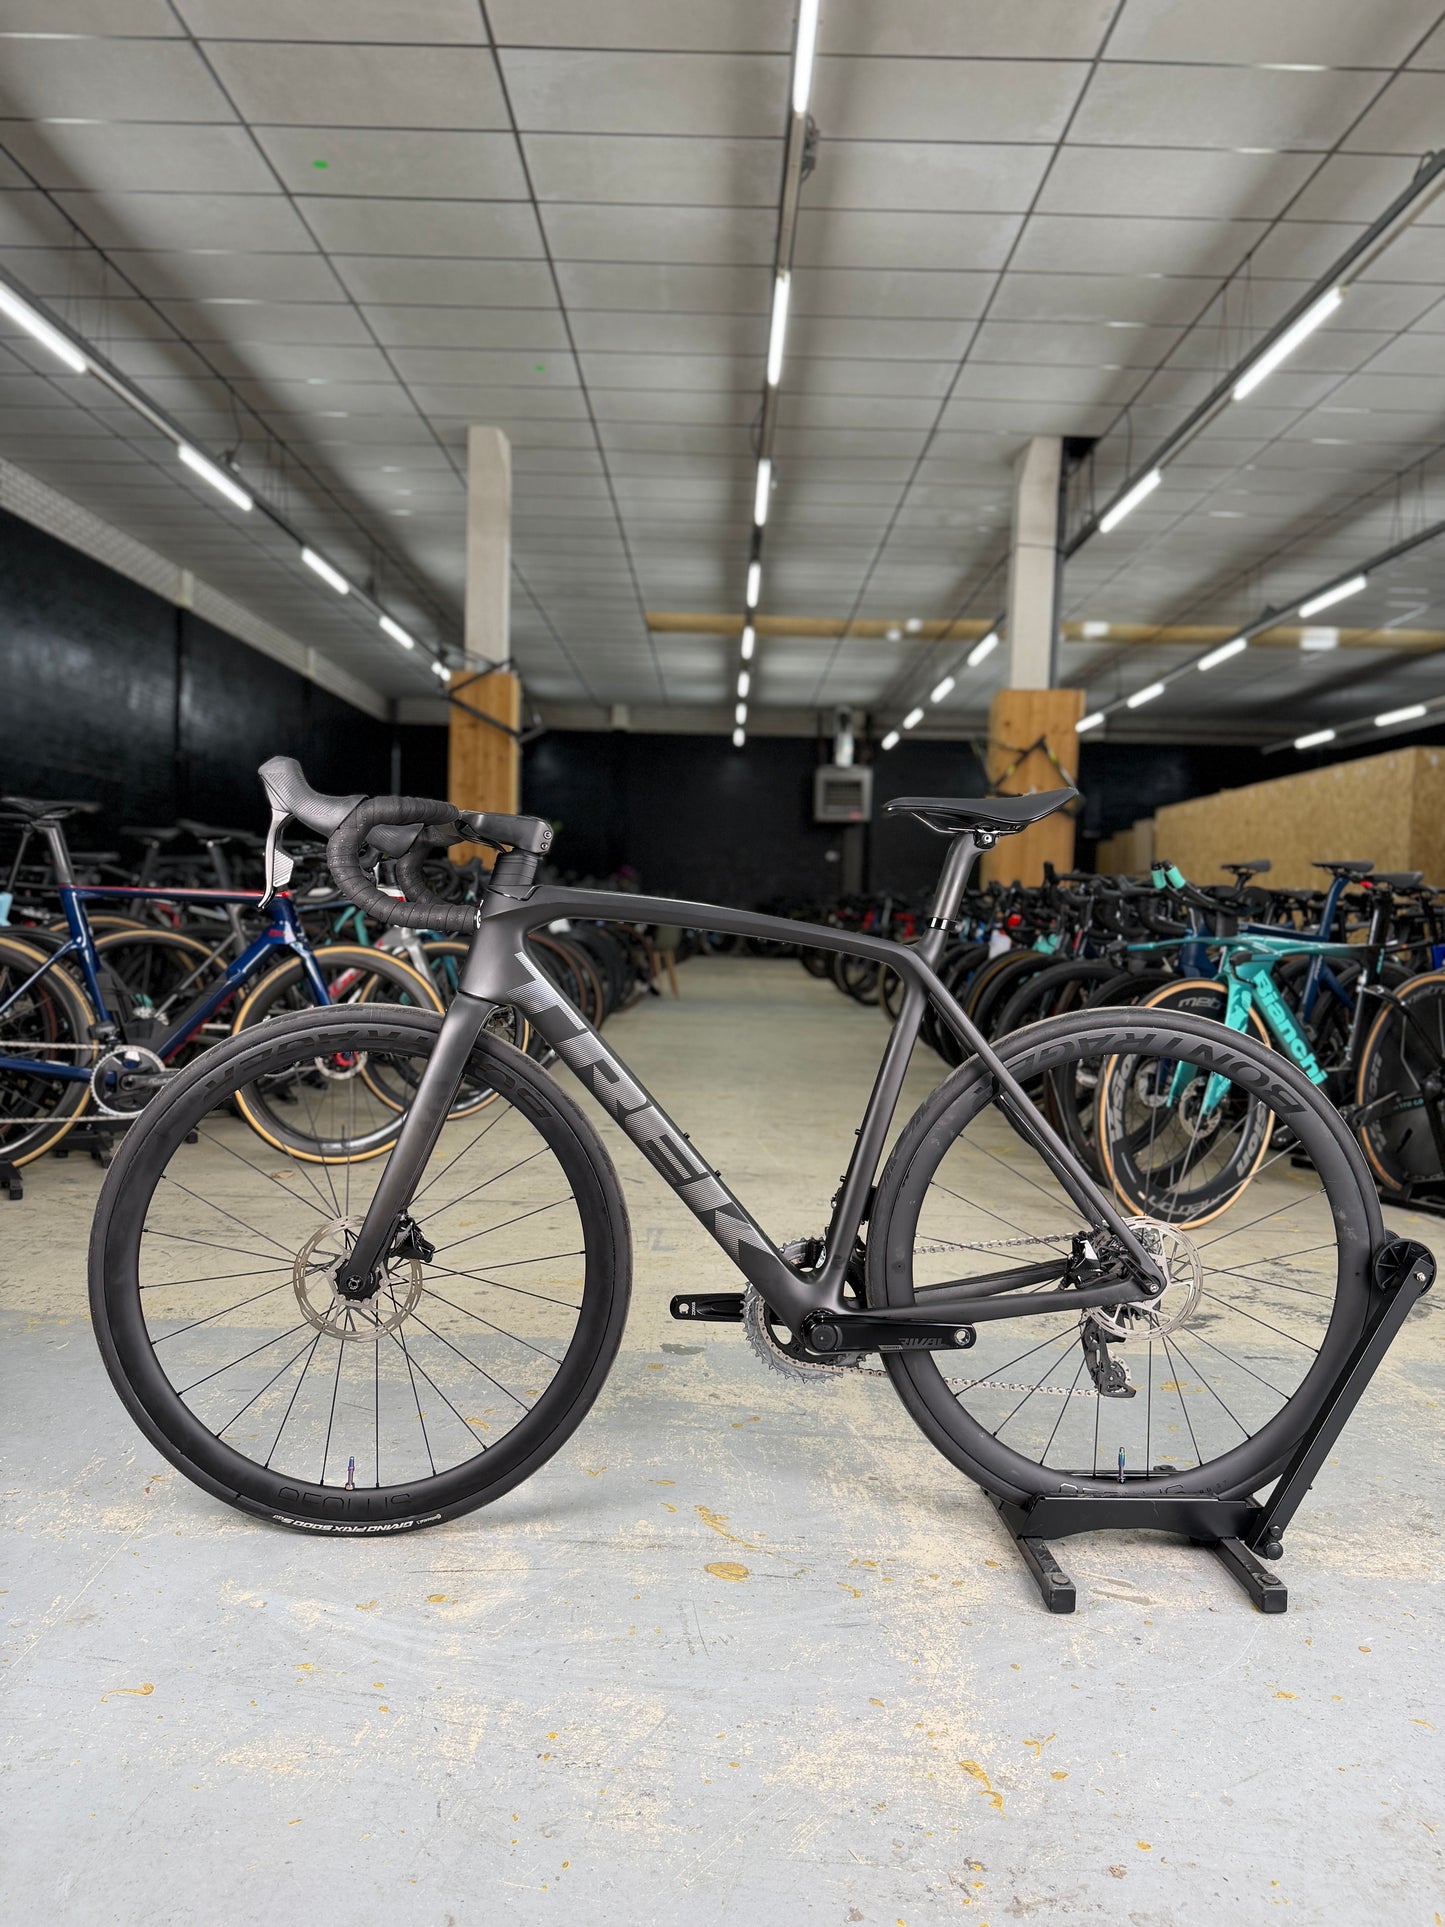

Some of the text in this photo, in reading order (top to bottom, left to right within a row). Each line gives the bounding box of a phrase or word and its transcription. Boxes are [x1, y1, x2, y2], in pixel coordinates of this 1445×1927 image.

[1253, 970, 1327, 1086] Bianchi
[506, 952, 777, 1265] TREK
[294, 1520, 333, 1531] 5000
[333, 1525, 368, 1533] PRIX
[367, 1519, 414, 1533] GRAND
